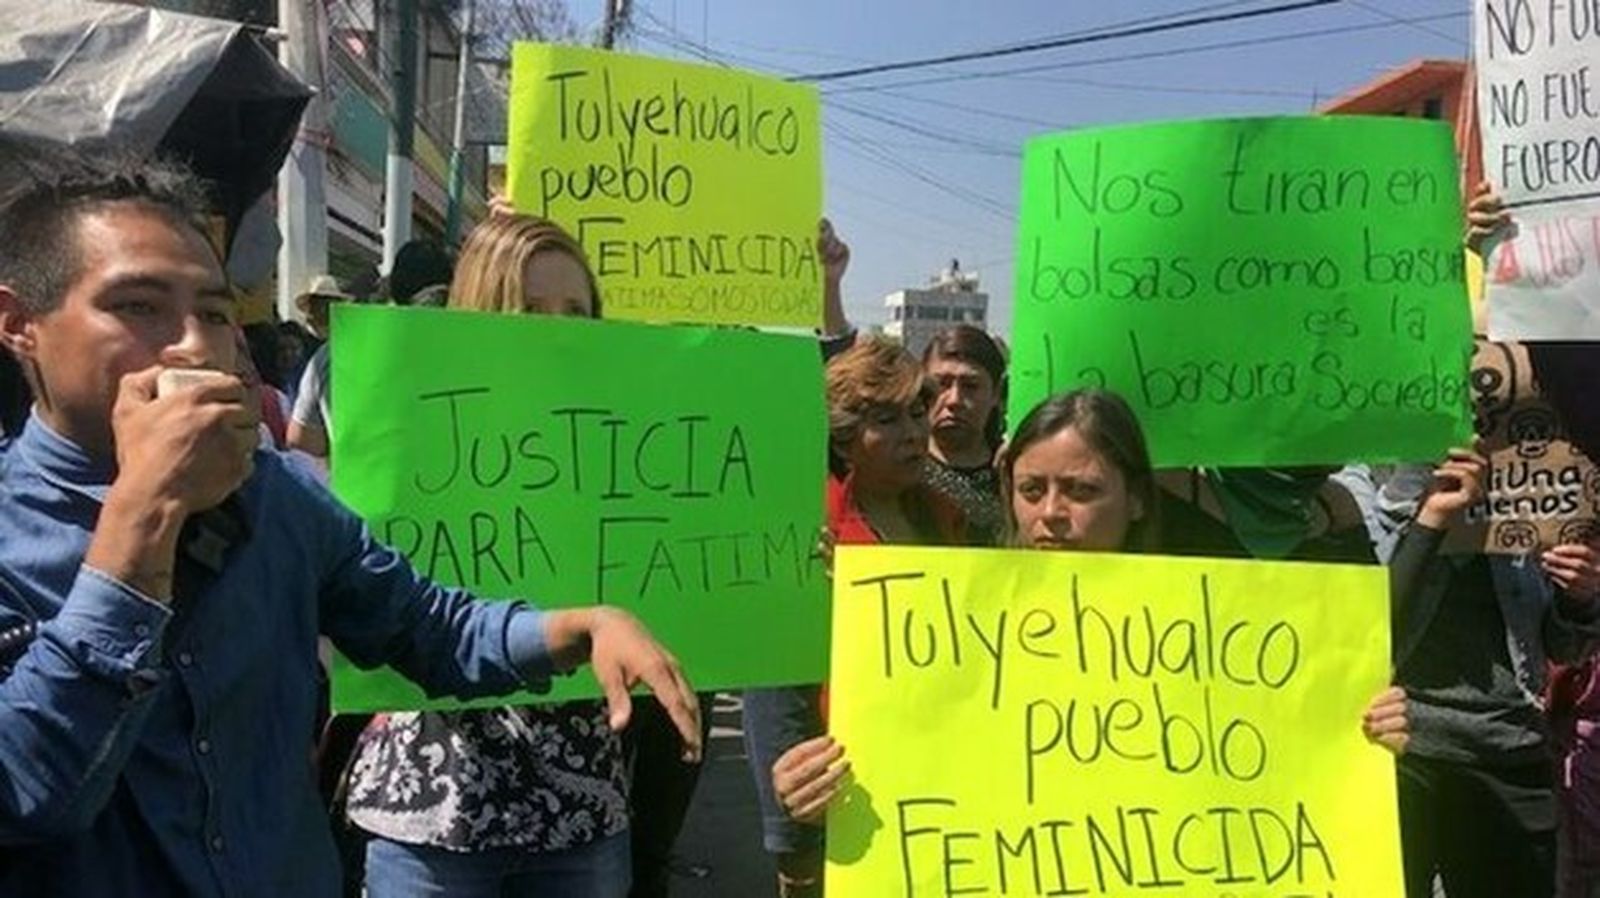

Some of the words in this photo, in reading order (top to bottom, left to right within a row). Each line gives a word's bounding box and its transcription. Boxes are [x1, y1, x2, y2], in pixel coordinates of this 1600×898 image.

[1486, 0, 1535, 58] NO
[546, 67, 800, 161] Tulyehualco
[1491, 79, 1528, 128] NO
[541, 142, 693, 218] pueblo
[1055, 141, 1183, 219] Nos
[1226, 133, 1371, 216] tiran
[1388, 167, 1437, 205] en
[1030, 227, 1197, 301] bolsas
[1216, 255, 1340, 295] como
[1364, 225, 1466, 288] basur
[1304, 305, 1359, 338] es
[1391, 296, 1427, 341] la
[1130, 330, 1296, 409] basura
[1311, 351, 1467, 411] Socieda
[415, 386, 755, 500] JUSTICIA
[386, 506, 557, 587] PARA
[852, 574, 1300, 709] Tulyehualco
[1026, 683, 1267, 803] pueblo
[896, 797, 1336, 898] FEMINICIDA
